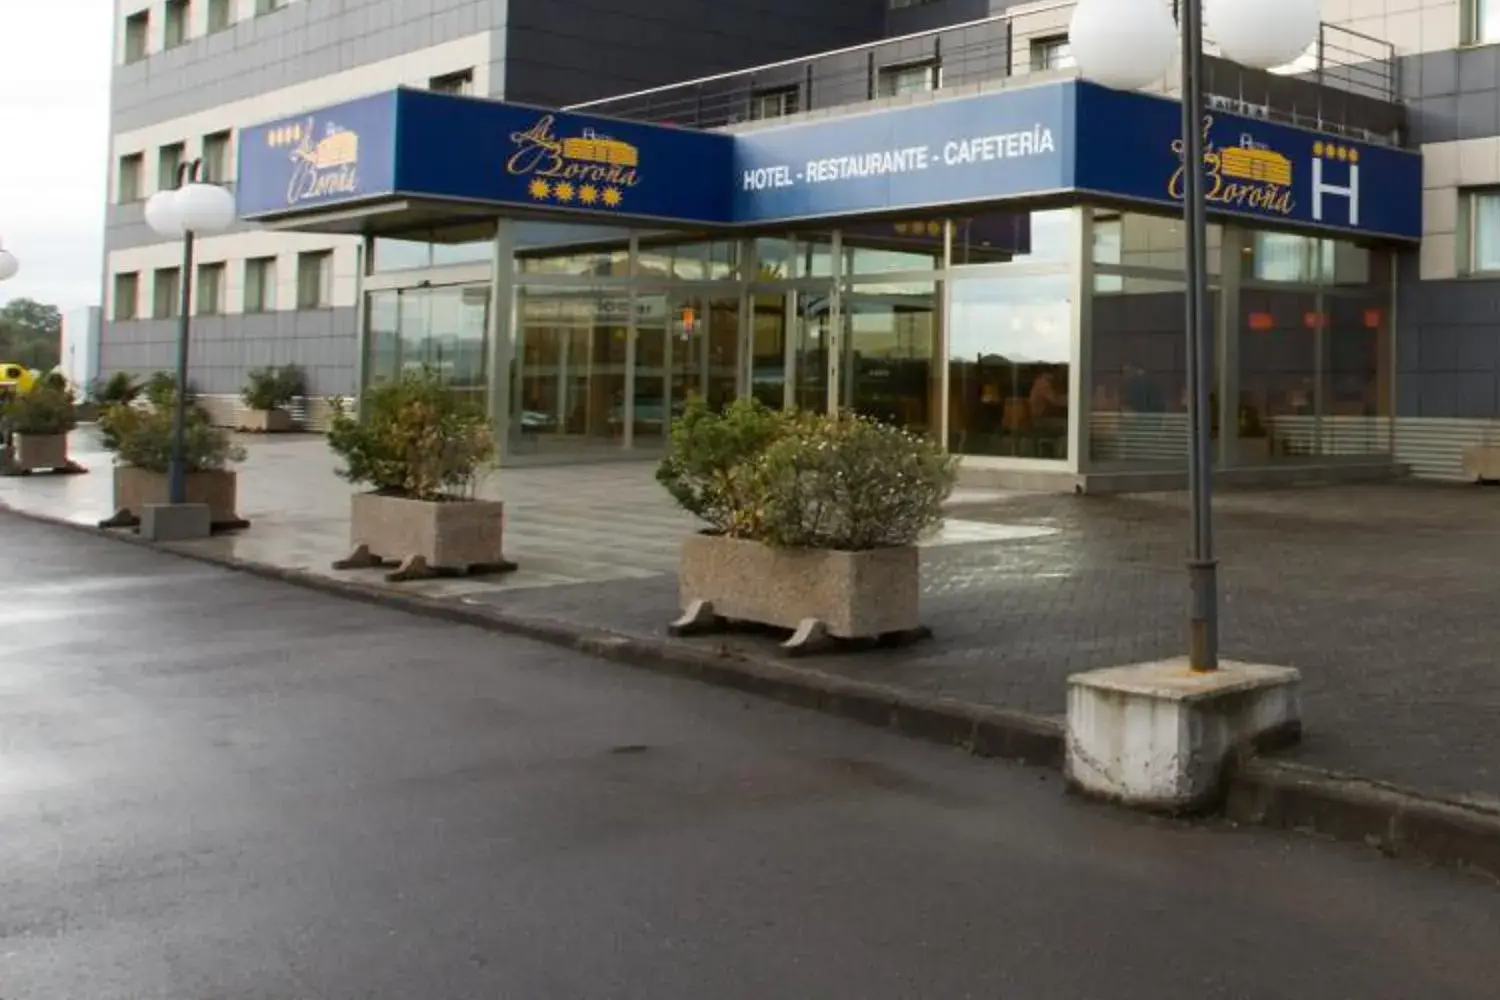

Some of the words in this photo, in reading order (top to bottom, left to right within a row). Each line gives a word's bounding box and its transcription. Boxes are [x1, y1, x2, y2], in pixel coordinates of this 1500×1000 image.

[743, 165, 793, 190] HOTEL
[806, 145, 928, 184] RESTAURANTE
[943, 123, 1054, 166] CAFETERÍA
[1312, 157, 1359, 225] H
